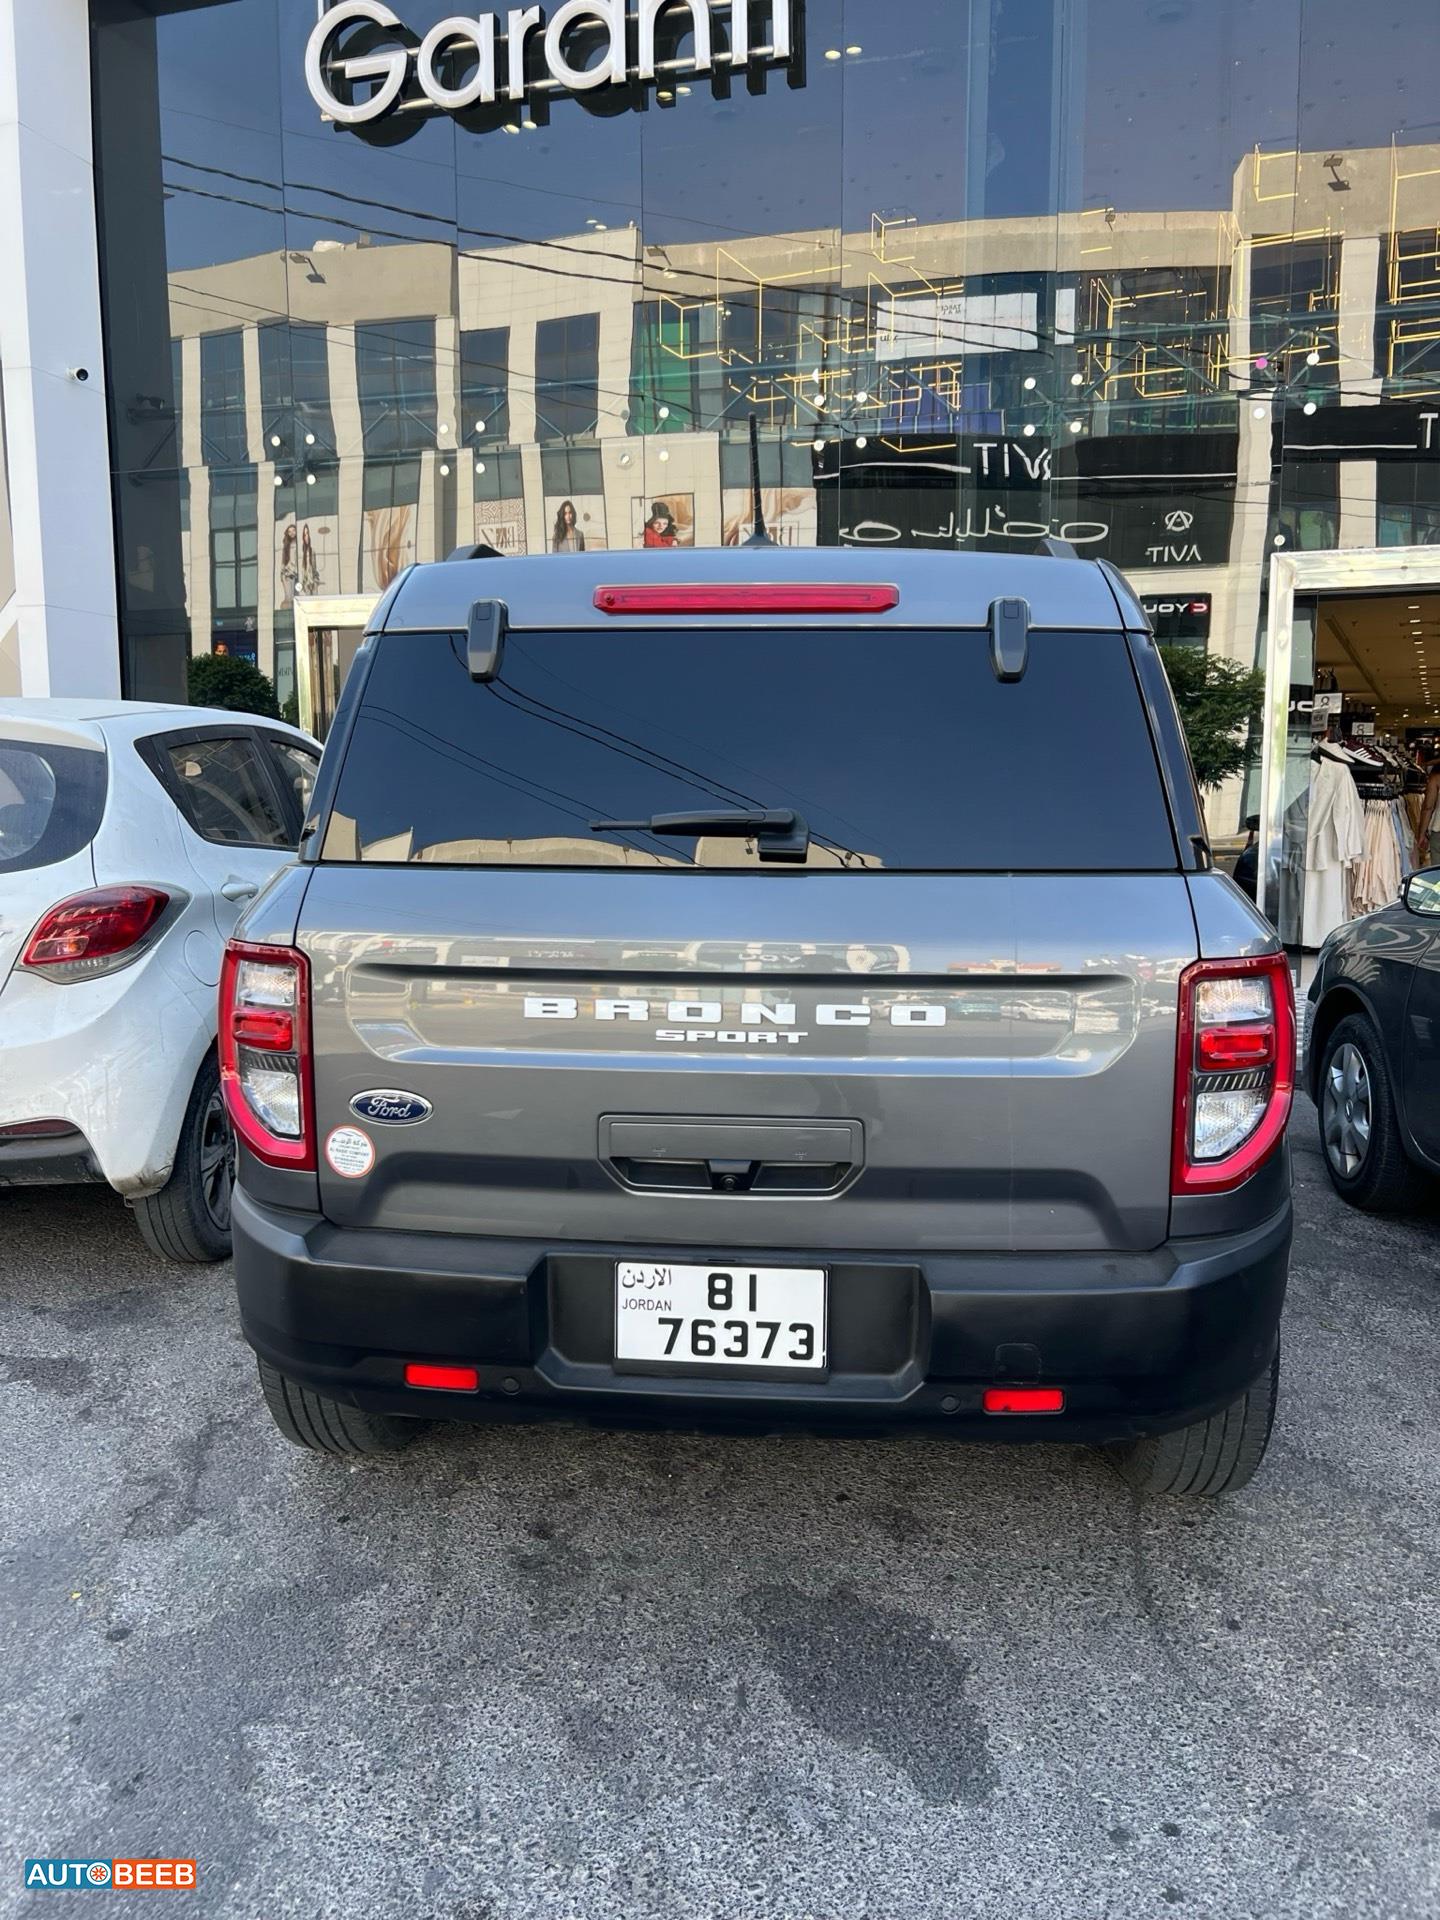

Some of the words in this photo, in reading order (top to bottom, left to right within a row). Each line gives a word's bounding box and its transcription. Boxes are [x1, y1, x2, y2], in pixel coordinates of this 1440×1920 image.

[523, 996, 947, 1027] BRONCO
[655, 1029, 808, 1044] SPORT
[368, 1096, 411, 1118] Ford
[622, 1298, 672, 1311] JORDAN
[707, 1272, 757, 1312] 81
[658, 1317, 814, 1360] 76373
